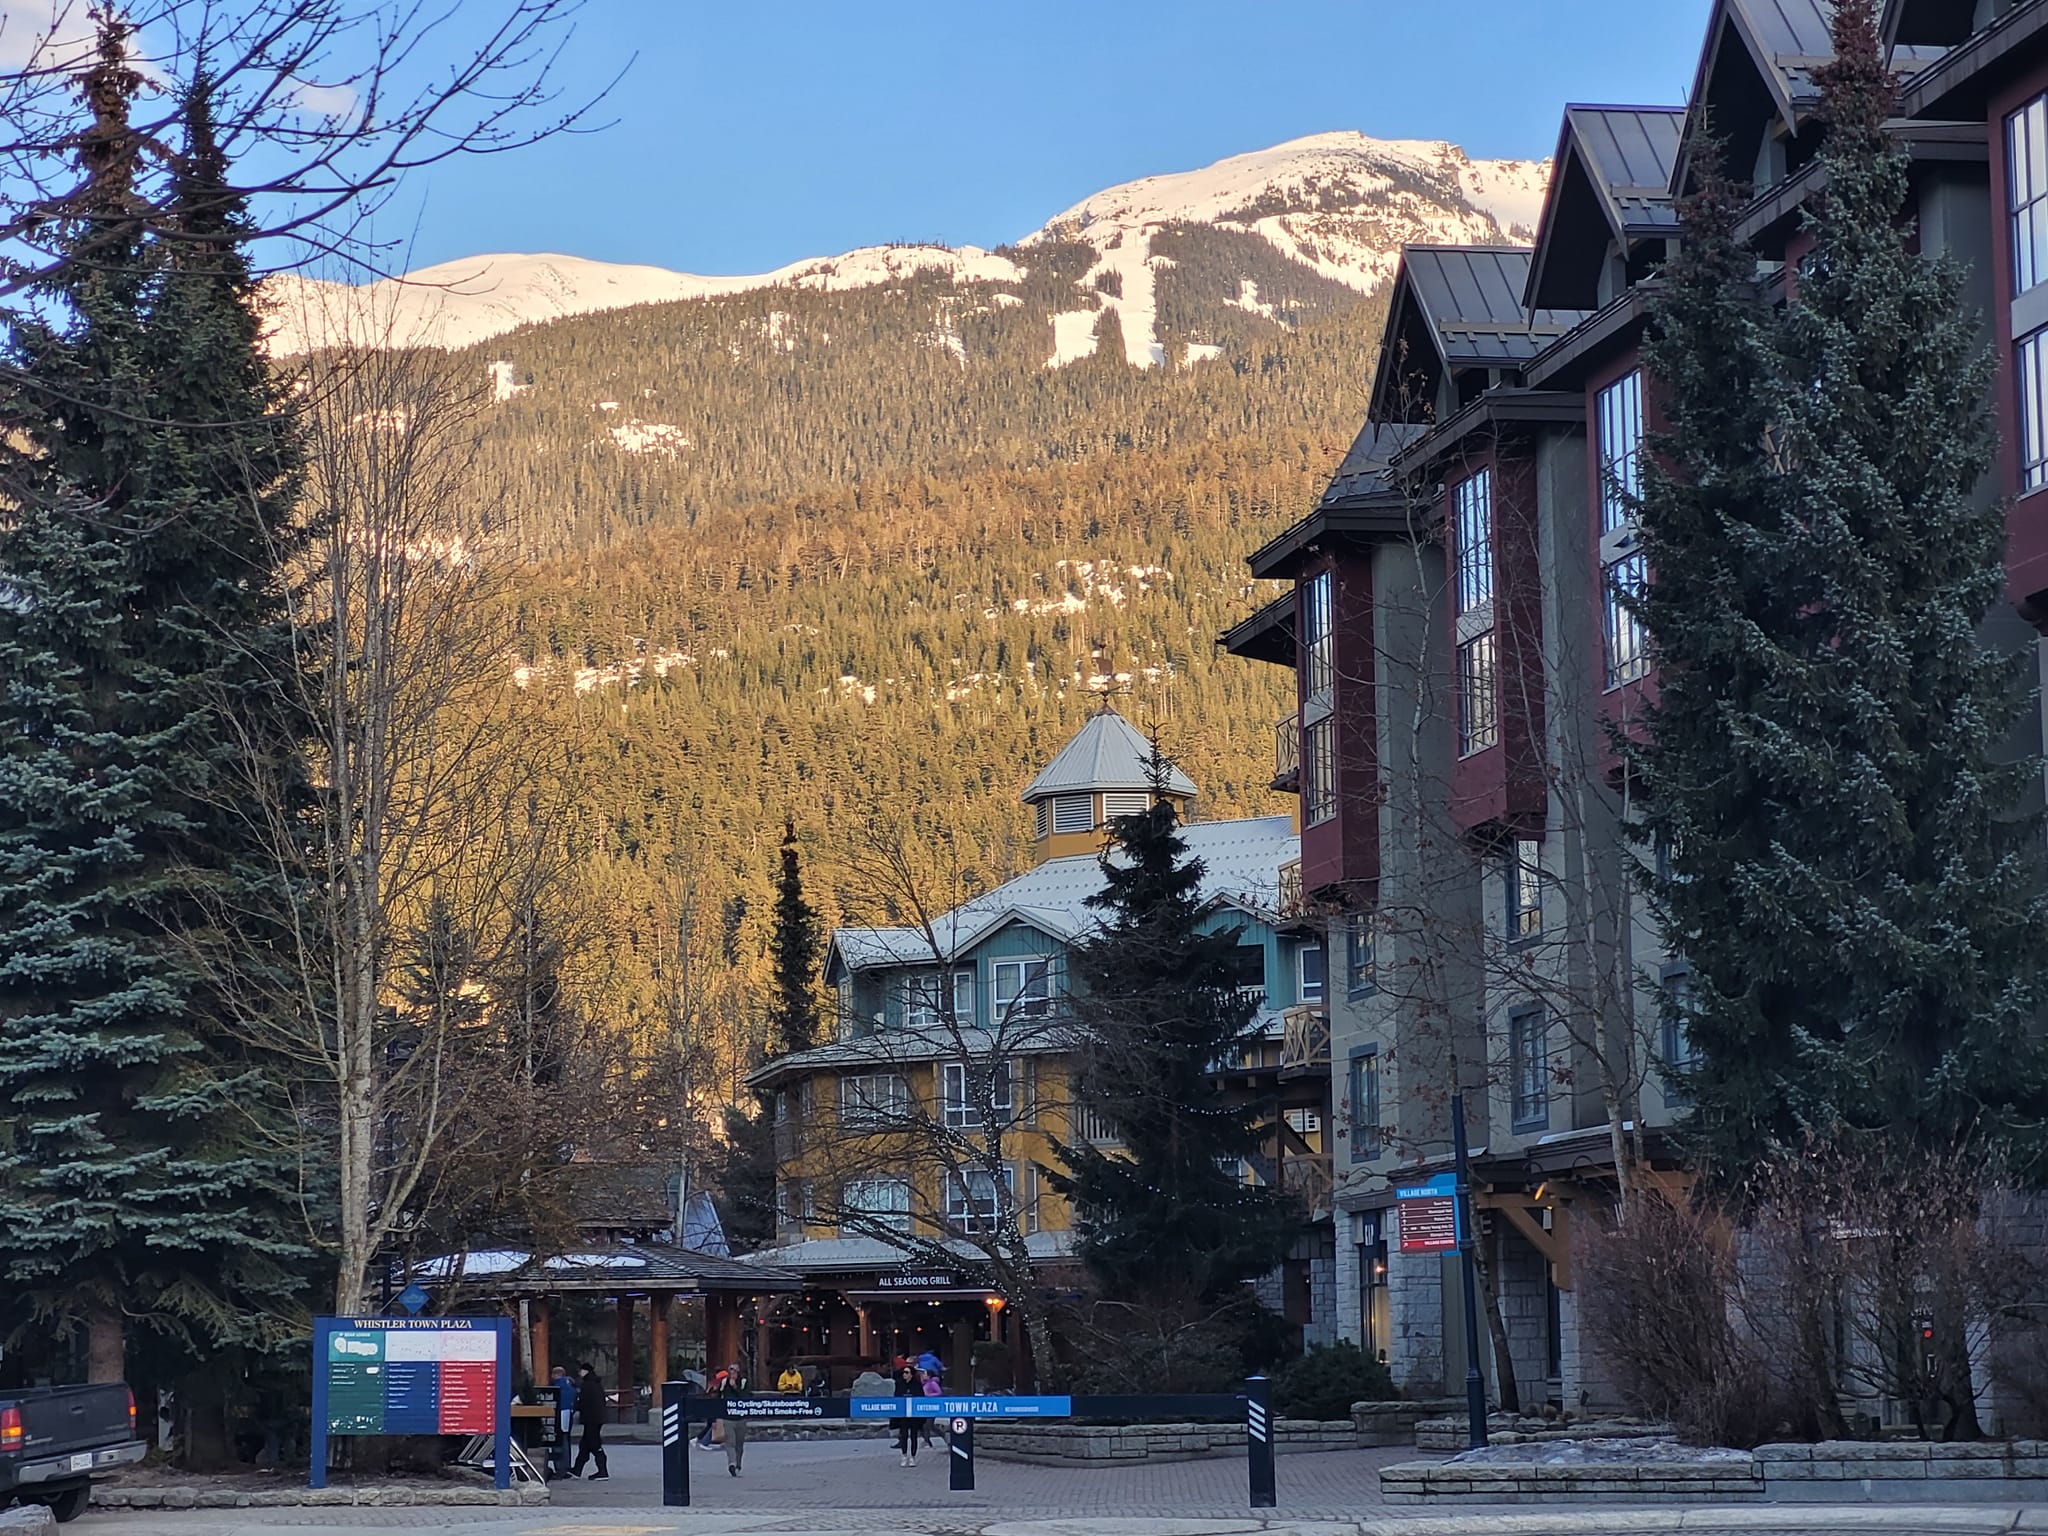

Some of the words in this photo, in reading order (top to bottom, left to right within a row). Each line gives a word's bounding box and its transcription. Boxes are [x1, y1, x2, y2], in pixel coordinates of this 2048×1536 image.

[1400, 1189, 1420, 1197] VILLAGE
[879, 1277, 893, 1286] ALL
[893, 1277, 929, 1286] SEASONS
[929, 1276, 951, 1285] GRILL
[354, 1319, 406, 1329] WHISTLER
[408, 1319, 439, 1329] TOWN
[440, 1319, 473, 1329] PLAZA
[726, 1400, 737, 1408] No
[737, 1400, 810, 1409] Cycling/Skateboarding
[861, 1403, 880, 1411] VILLAGE
[944, 1401, 969, 1413] TOWN
[971, 1401, 998, 1413] PLAZA
[727, 1408, 749, 1416] Village
